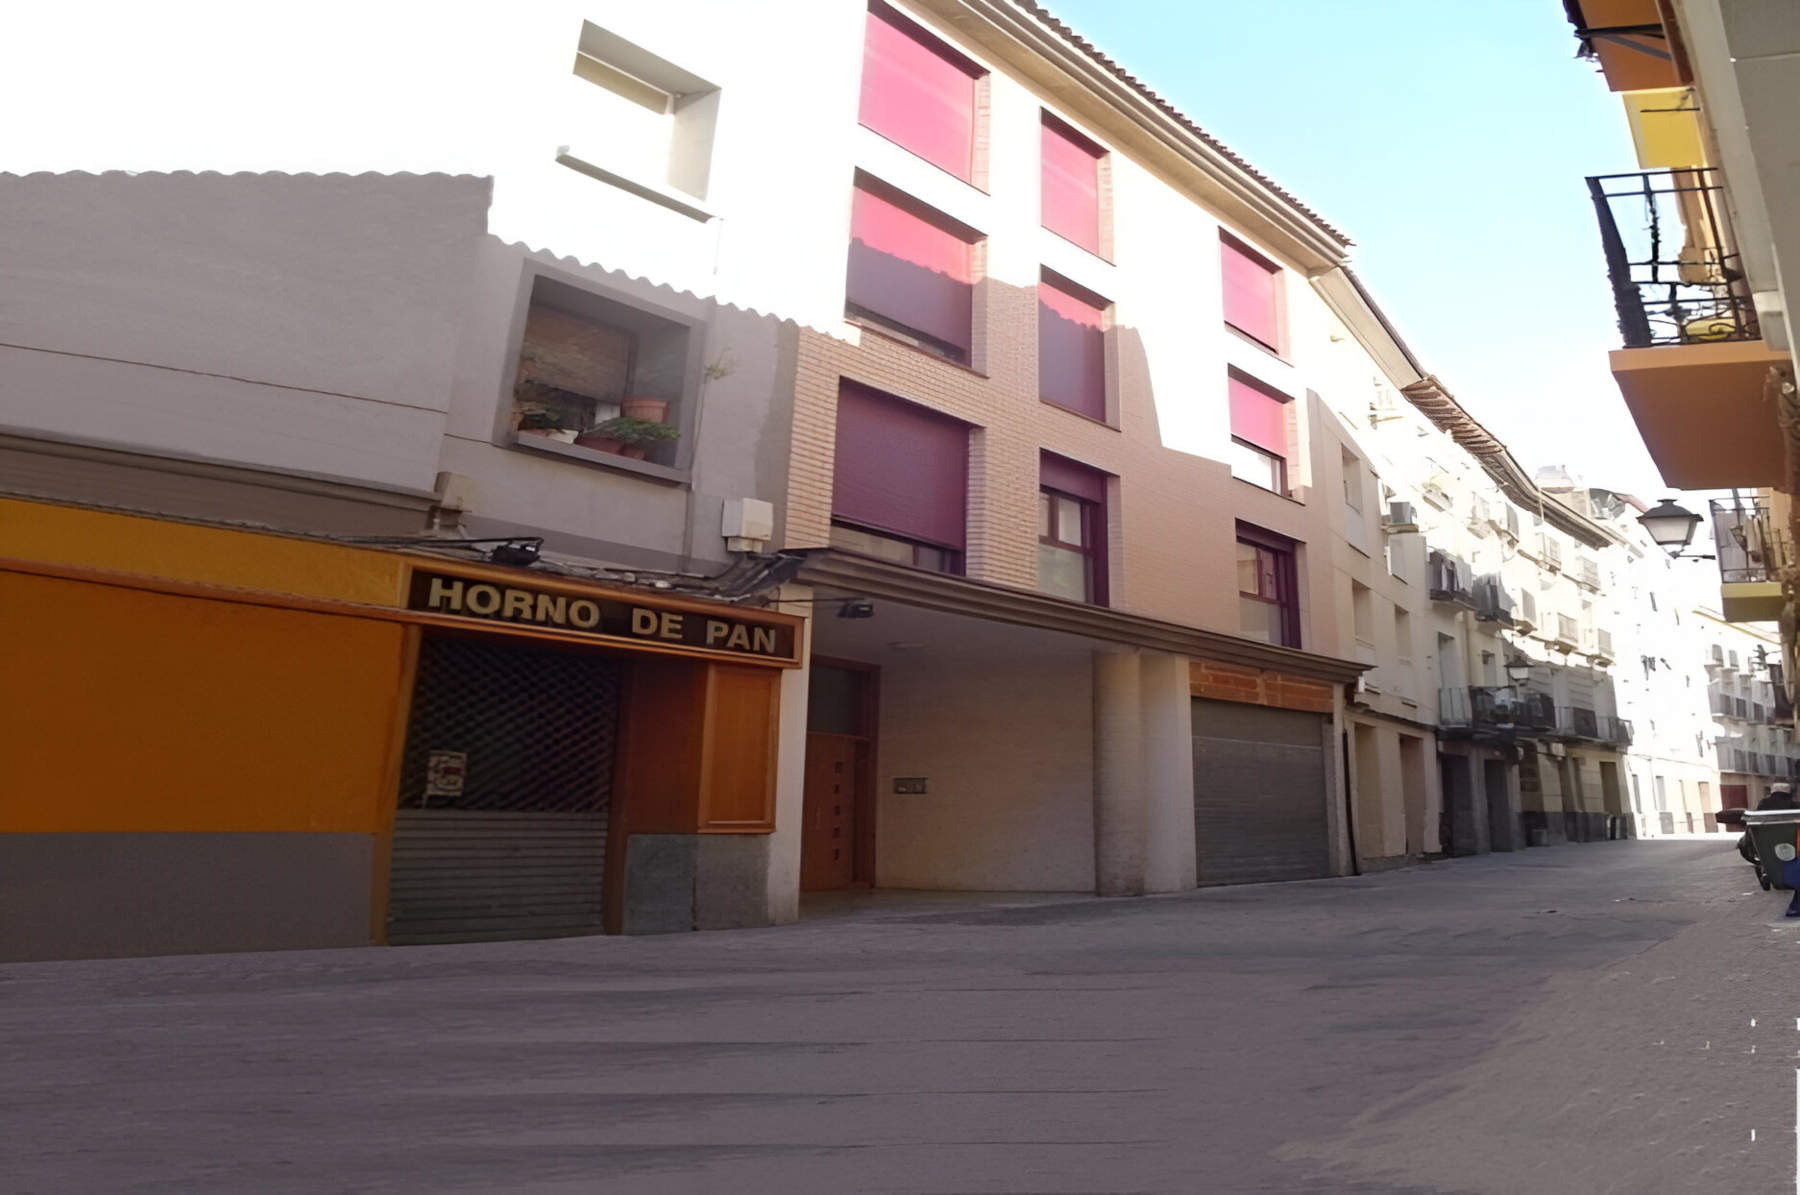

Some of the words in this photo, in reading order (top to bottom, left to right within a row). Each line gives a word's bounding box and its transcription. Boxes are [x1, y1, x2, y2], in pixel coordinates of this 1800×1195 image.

[428, 578, 599, 628] HORNO
[632, 608, 683, 640] DE
[706, 621, 776, 653] PAN
